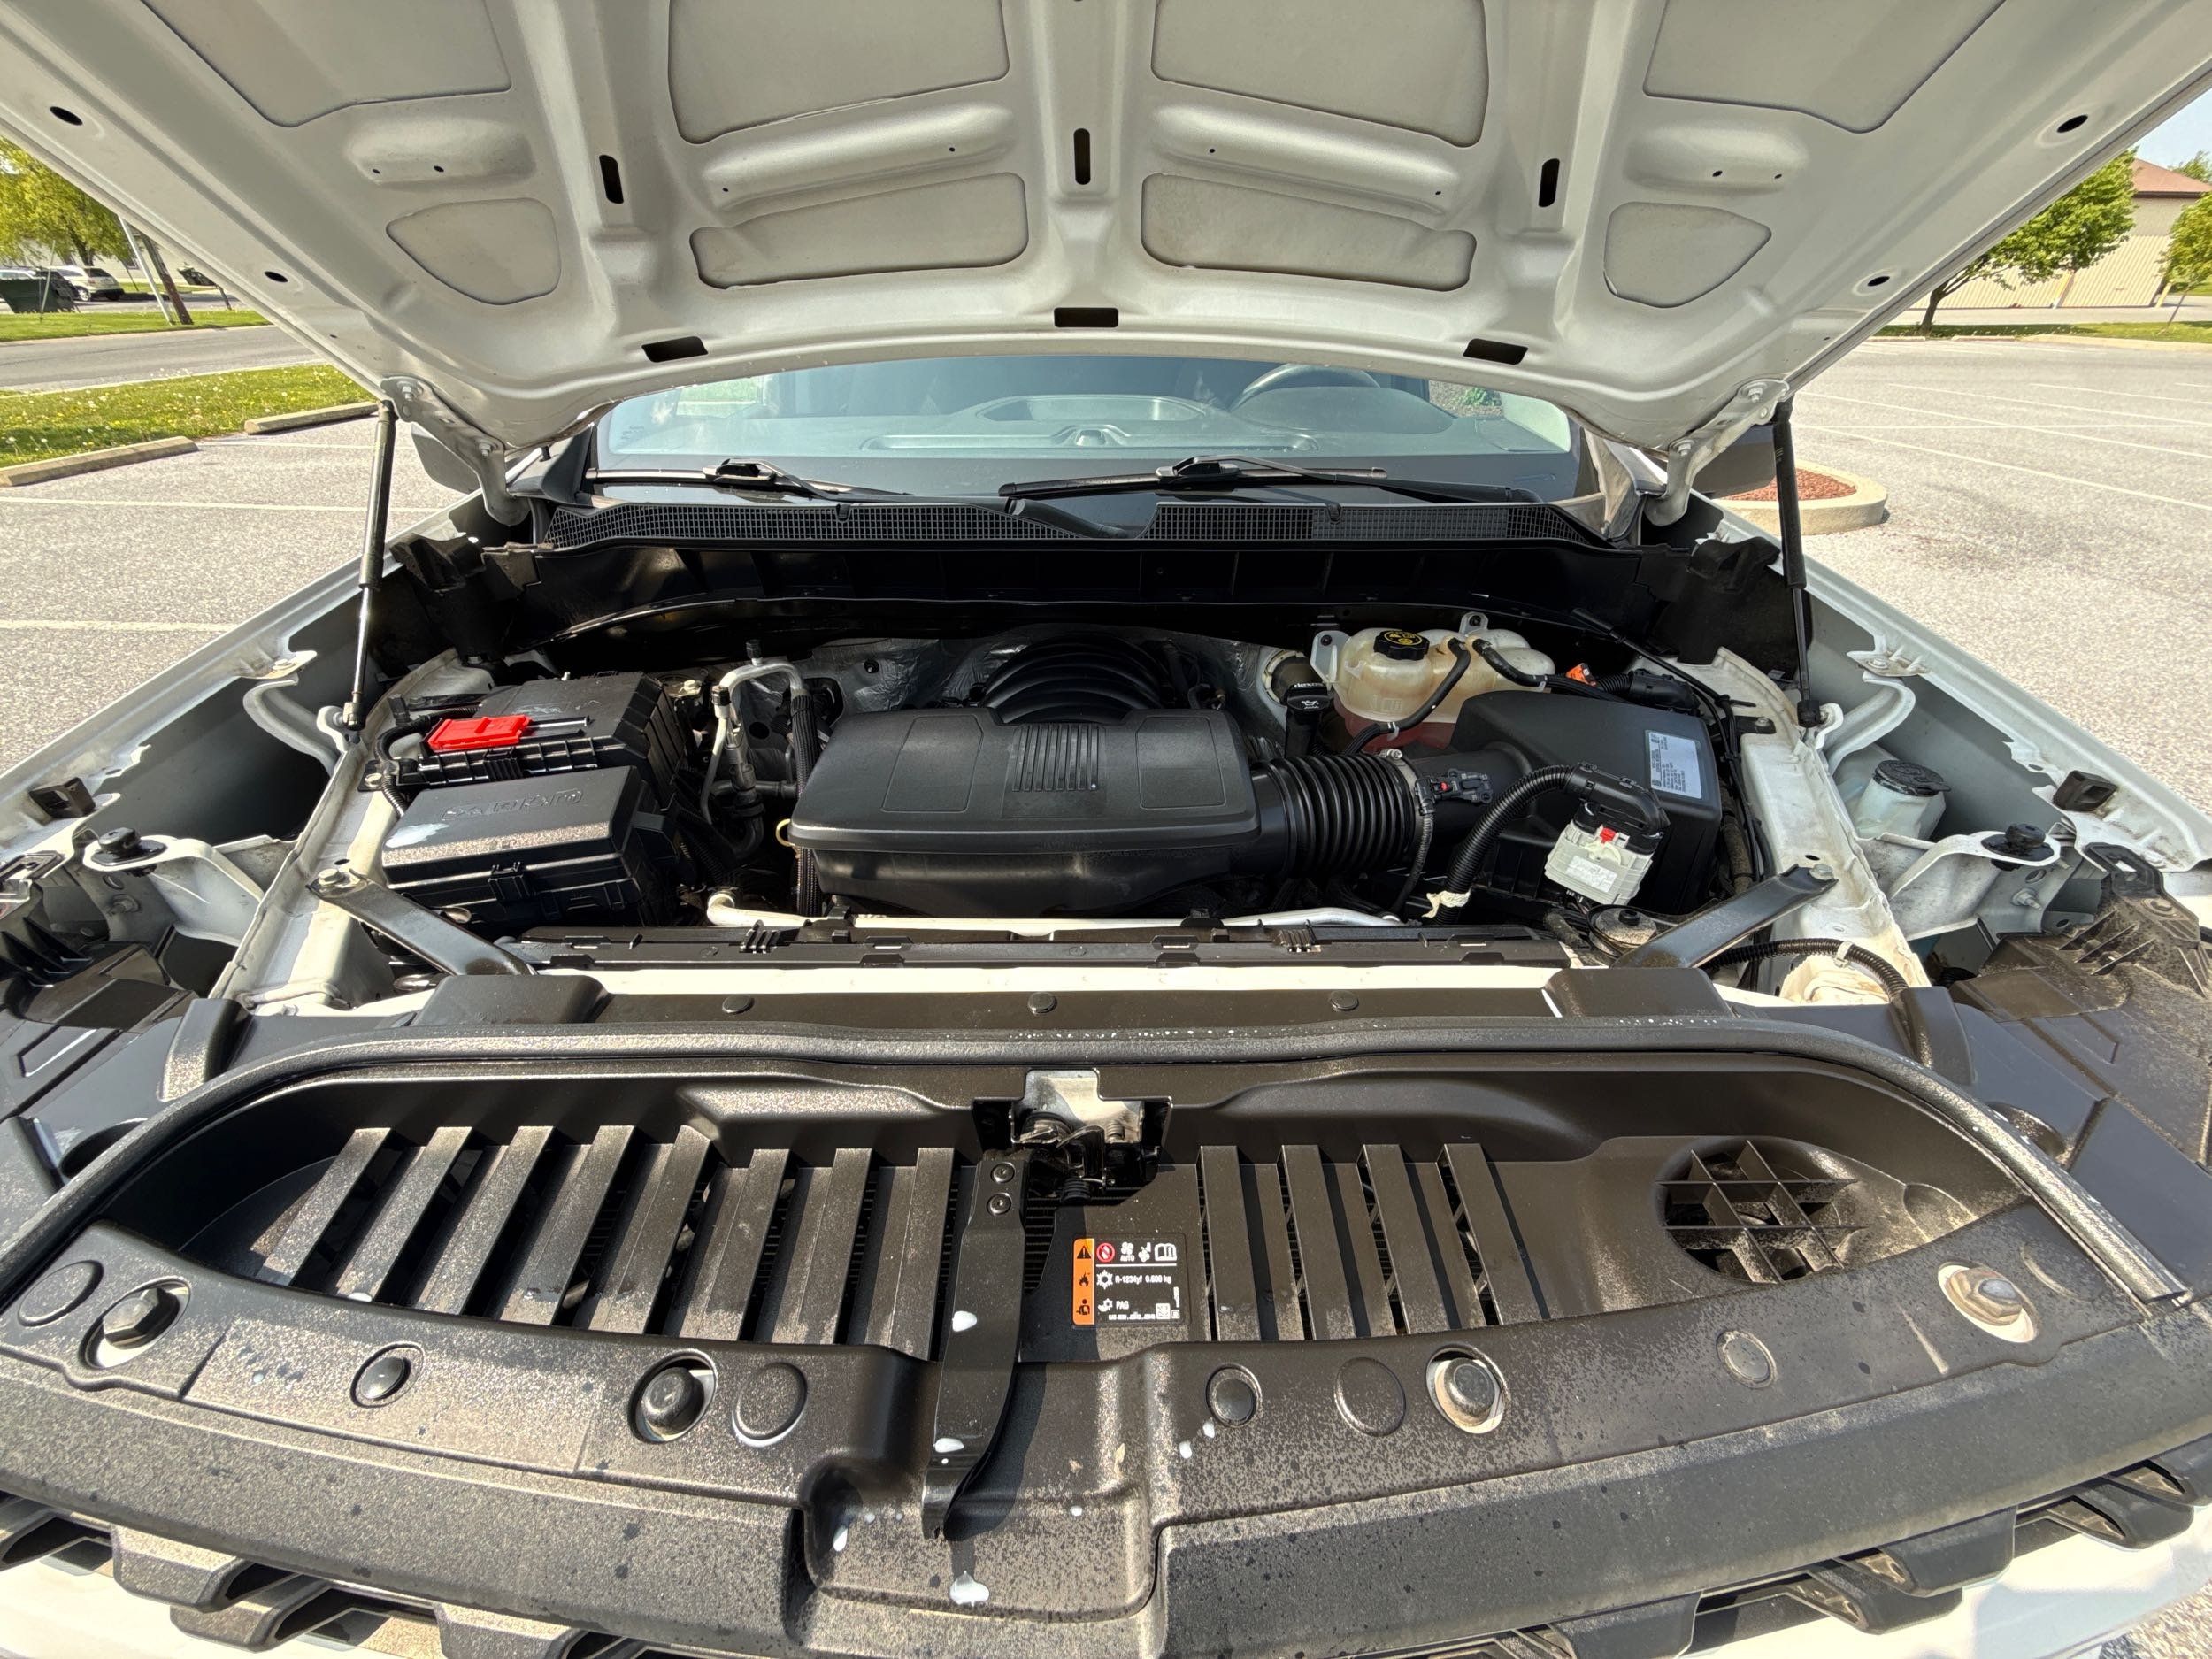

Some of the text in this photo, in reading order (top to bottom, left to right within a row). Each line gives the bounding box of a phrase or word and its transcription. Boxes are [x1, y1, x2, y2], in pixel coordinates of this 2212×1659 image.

[1115, 1274, 1143, 1286] R-1234yf
[1163, 1274, 1172, 1285] kg
[1116, 1300, 1130, 1310] PAG
